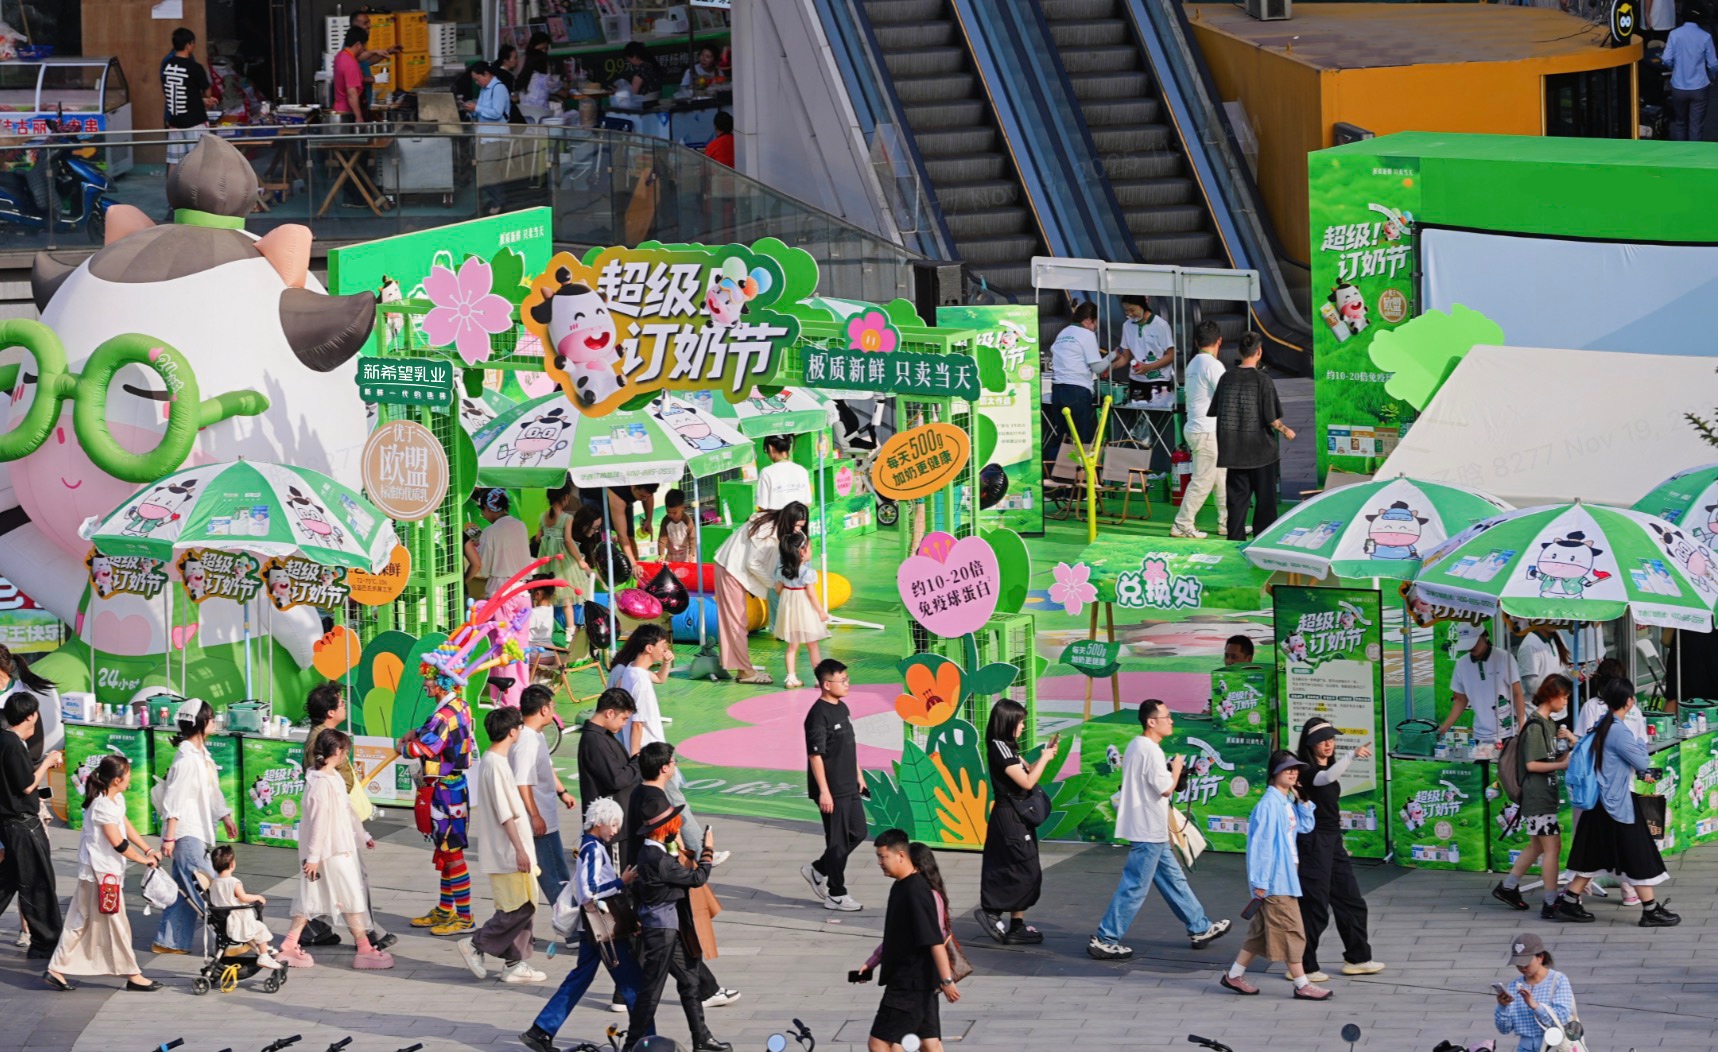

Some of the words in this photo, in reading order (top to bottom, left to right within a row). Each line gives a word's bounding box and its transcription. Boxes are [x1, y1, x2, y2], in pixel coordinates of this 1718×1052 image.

[1321, 222, 1382, 251] 超级!
[1337, 245, 1412, 281] 订奶节
[621, 322, 788, 392] 订奶节
[363, 364, 446, 383] 新希望乳业
[896, 361, 972, 391] 只卖当天
[393, 423, 416, 443] 优于
[886, 428, 944, 469] 每天500g
[379, 443, 431, 488] 欧盟
[892, 449, 952, 487] 加奶更健康
[113, 569, 165, 600] 订奶节
[204, 573, 259, 601] 订奶节
[290, 579, 352, 609] 订奶节
[911, 560, 984, 598] 约10-20倍
[1118, 573, 1199, 608] 兑换处
[918, 580, 991, 619] 免疫球蛋白
[1296, 611, 1343, 633] 超级!
[1309, 628, 1367, 655] 订奶节
[1414, 789, 1445, 803] 超级!
[1422, 801, 1463, 818] 订奶节
